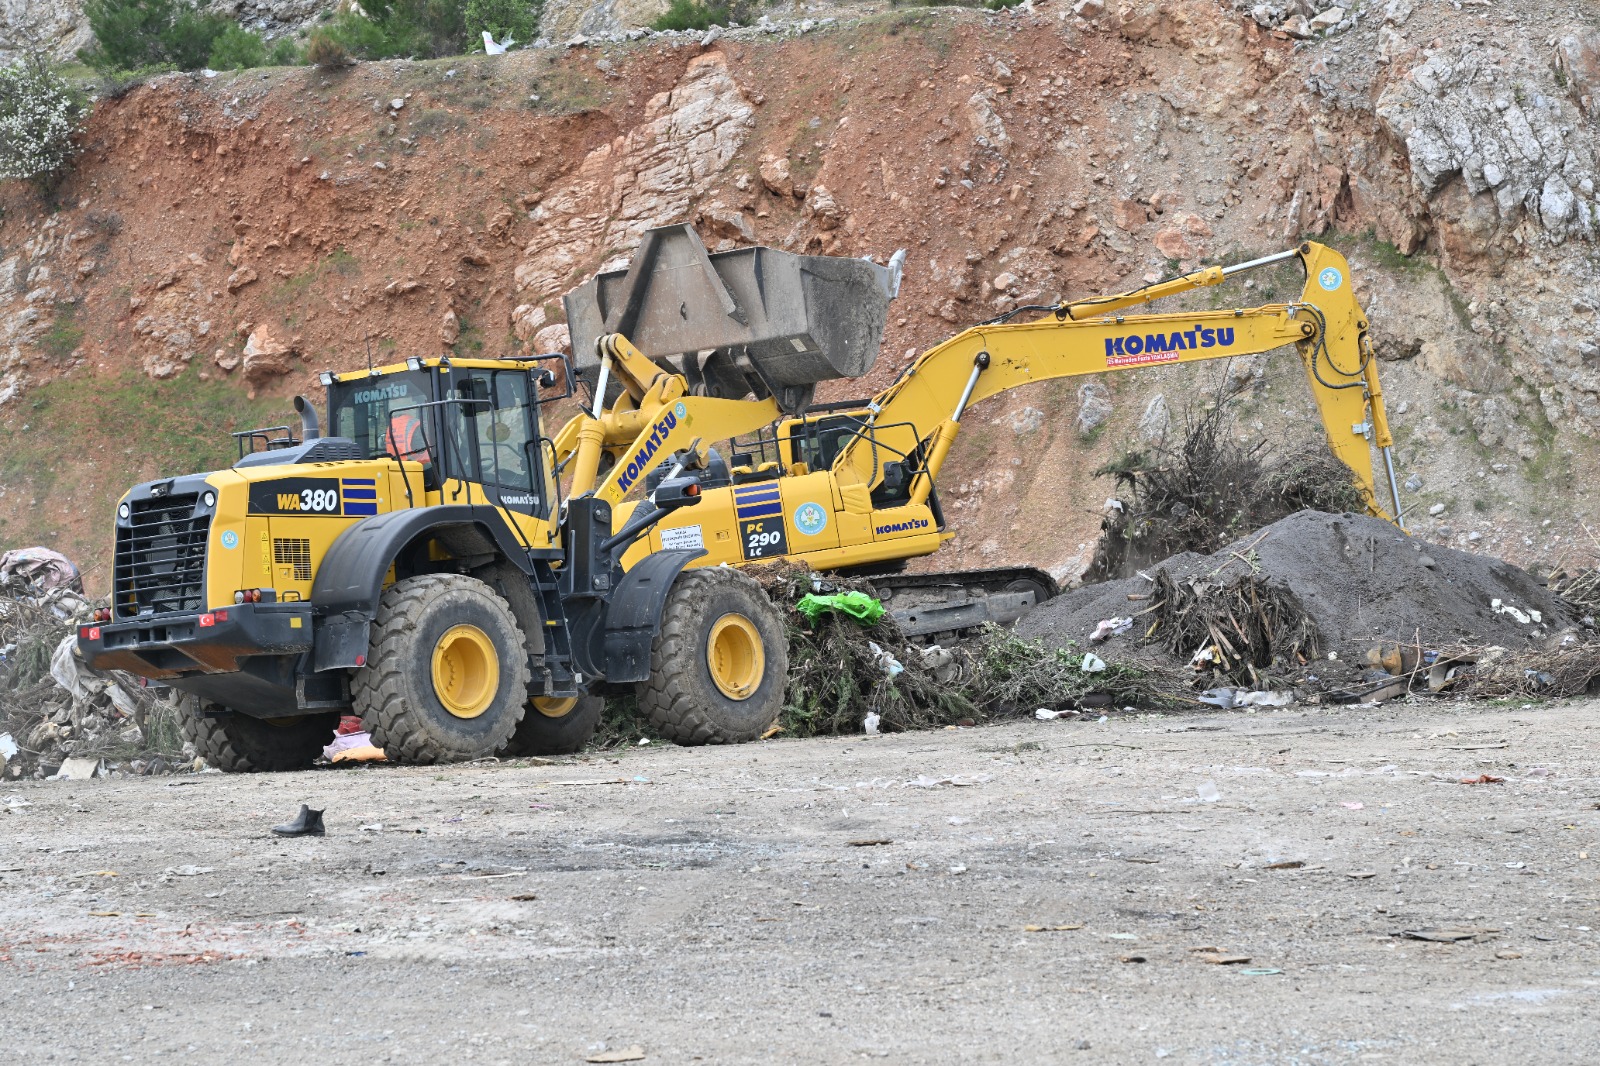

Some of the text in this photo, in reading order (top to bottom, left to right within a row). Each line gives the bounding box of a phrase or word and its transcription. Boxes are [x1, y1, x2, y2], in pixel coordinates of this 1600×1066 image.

[1104, 324, 1235, 356] KOMATSU
[354, 383, 407, 404] KOMATSU
[617, 410, 677, 493] KOMATSU
[277, 489, 338, 511] WA380
[500, 493, 540, 505] KOMATSU
[746, 522, 764, 534] PC
[875, 518, 929, 535] KOMATSU
[748, 531, 781, 548] 290
[750, 547, 762, 557] LC
